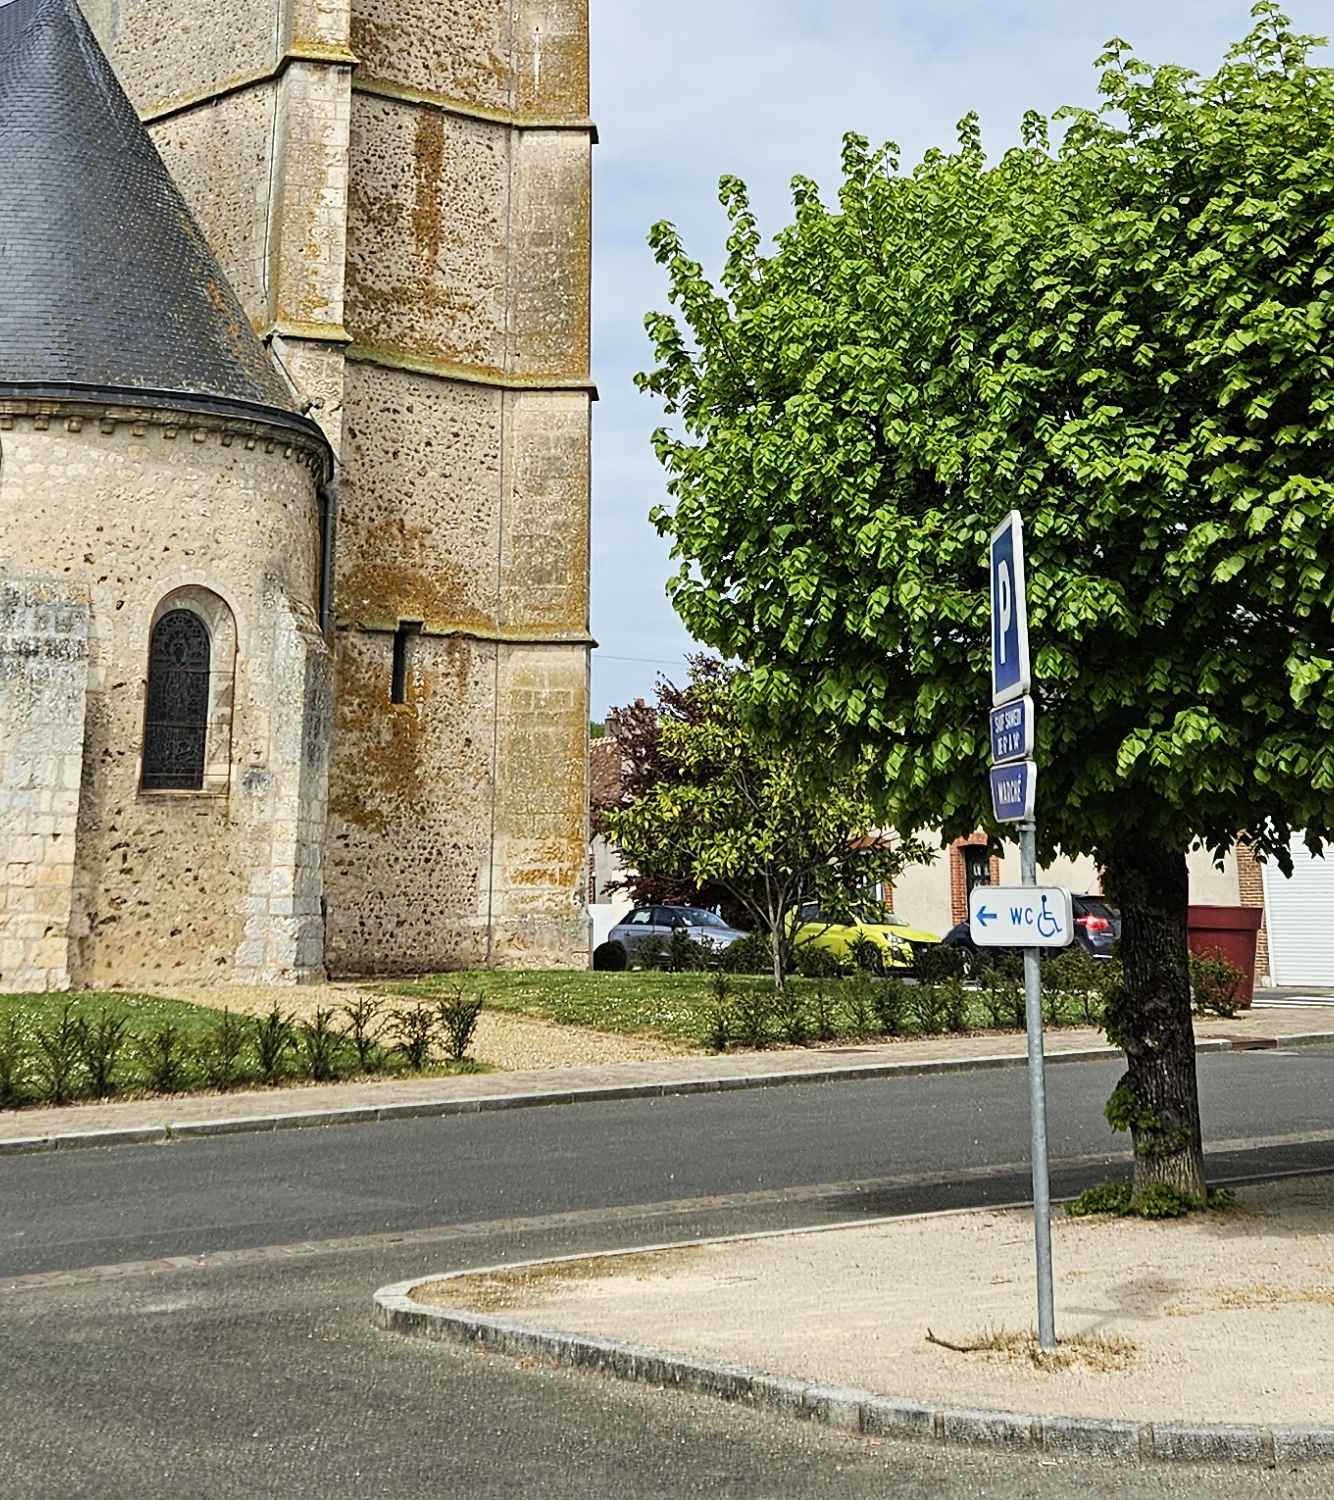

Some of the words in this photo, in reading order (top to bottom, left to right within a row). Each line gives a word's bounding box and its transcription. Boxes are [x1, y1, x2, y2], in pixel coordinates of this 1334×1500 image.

[998, 560, 1011, 664] P
[1005, 708, 1021, 729] SAMEDI
[997, 773, 1022, 805] MARCHÉ
[1010, 907, 1034, 925] WC
